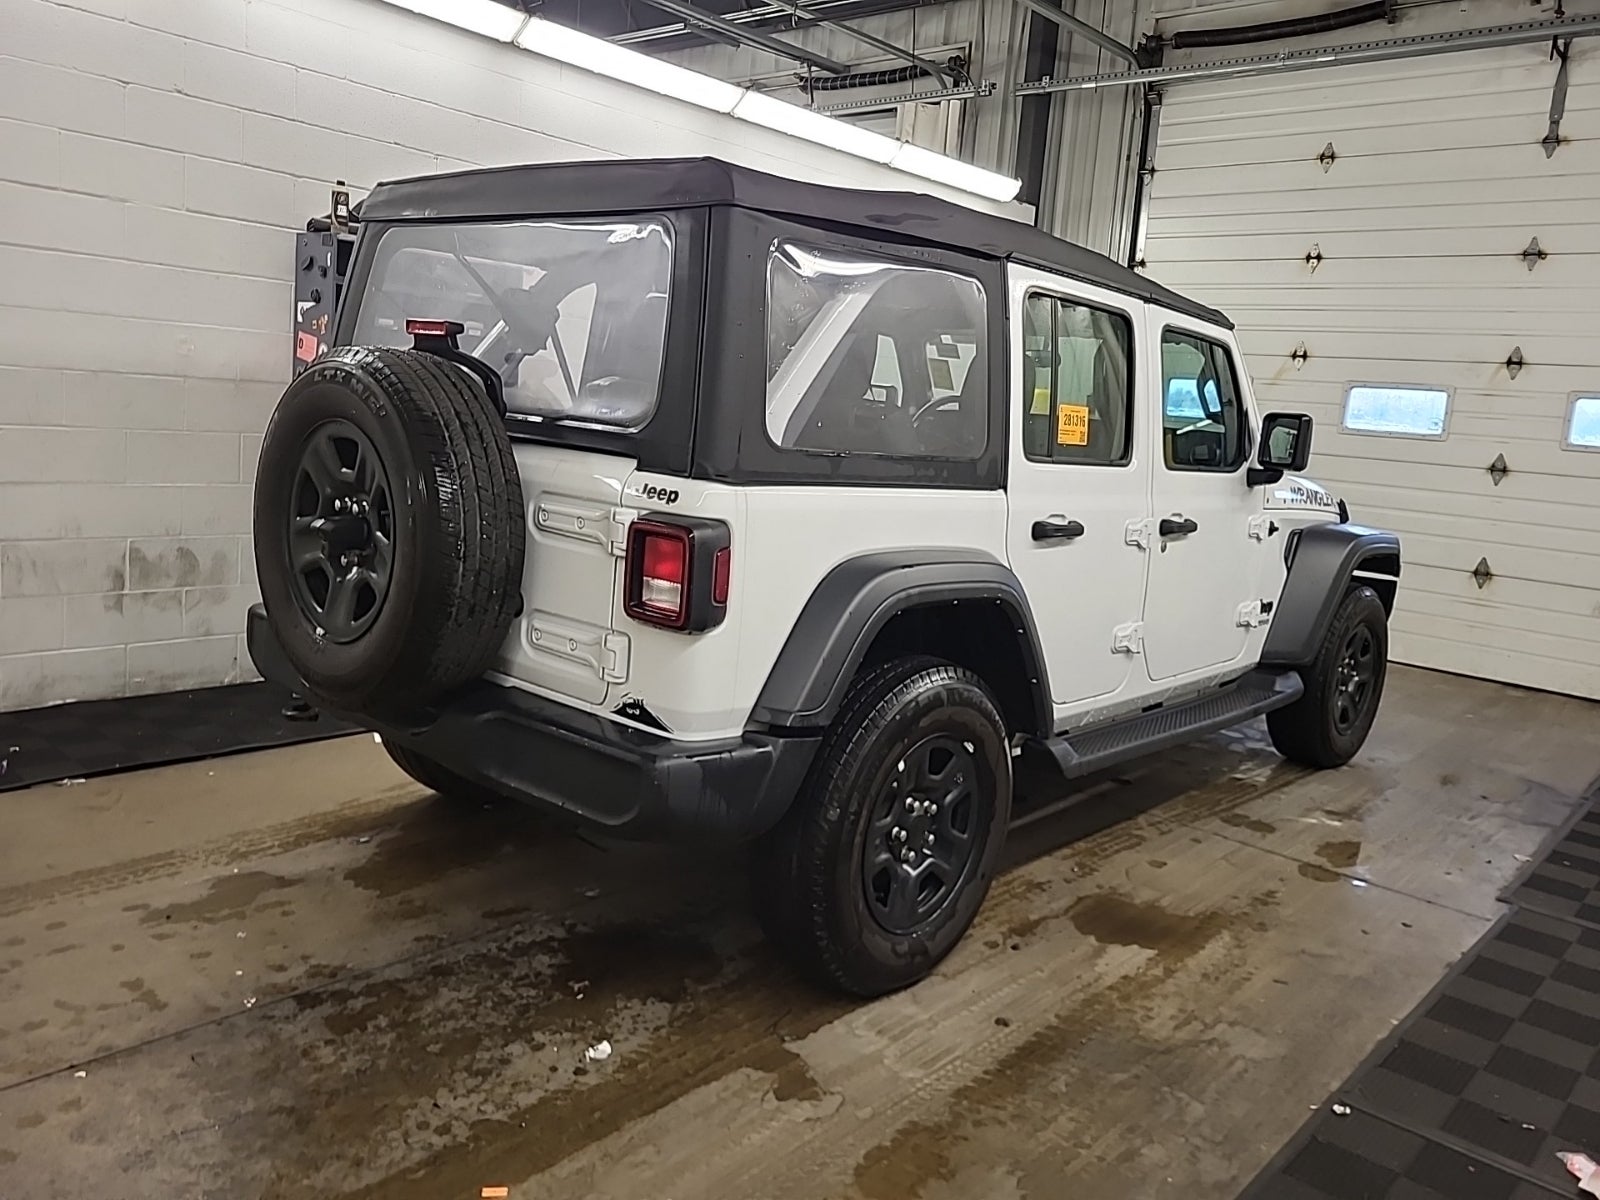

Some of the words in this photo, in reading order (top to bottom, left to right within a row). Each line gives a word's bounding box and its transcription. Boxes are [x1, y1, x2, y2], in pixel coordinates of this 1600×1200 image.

[313, 369, 346, 382] LTX
[1063, 413, 1086, 428] 281316
[635, 482, 680, 506] Jeep
